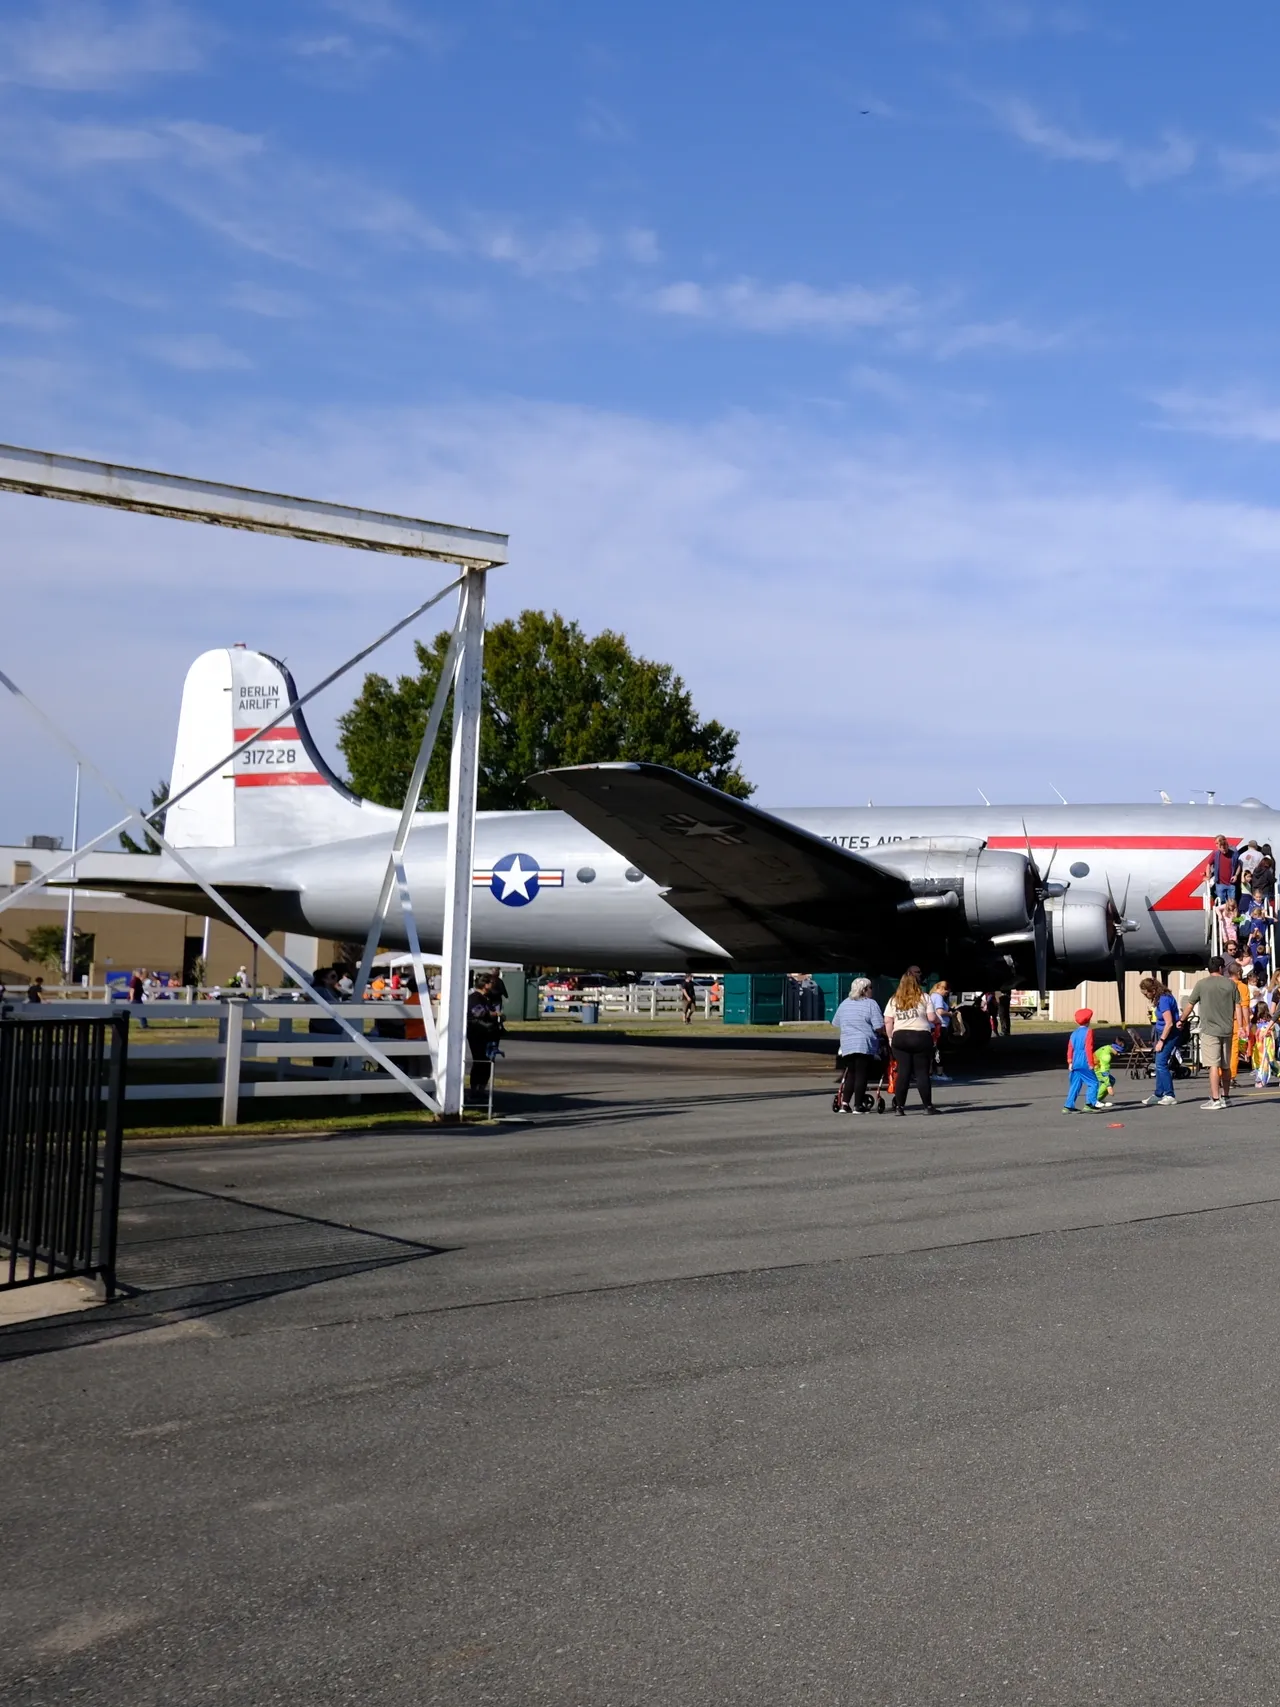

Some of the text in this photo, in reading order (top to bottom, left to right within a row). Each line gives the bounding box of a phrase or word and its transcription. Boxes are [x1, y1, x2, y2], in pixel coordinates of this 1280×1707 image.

[240, 686, 279, 698] BERLIN
[239, 698, 280, 711] AIRLIFT
[242, 749, 296, 765] 317228
[821, 836, 870, 849] TATES
